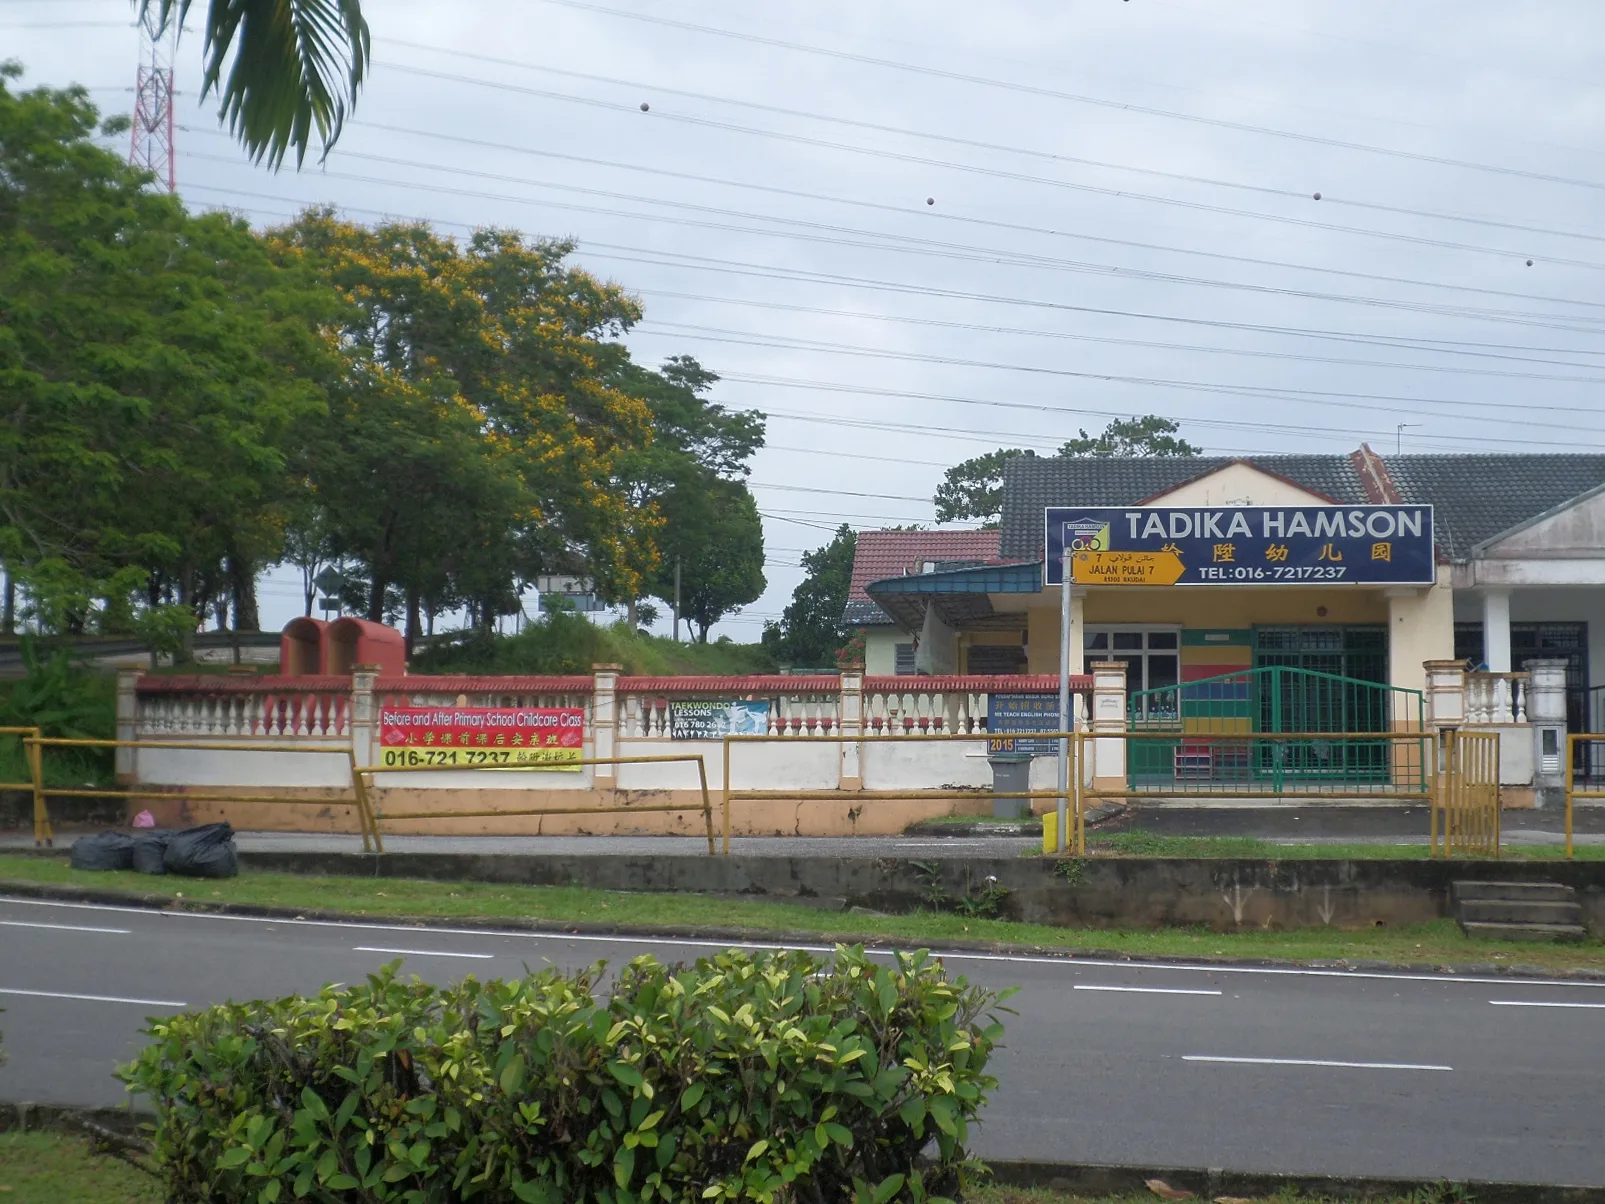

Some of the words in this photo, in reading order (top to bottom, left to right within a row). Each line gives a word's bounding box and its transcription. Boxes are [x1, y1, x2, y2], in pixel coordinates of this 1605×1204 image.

[1125, 512, 1253, 539] TADIKA
[1263, 510, 1422, 538] HAMSON
[1089, 565, 1118, 575] JALAN
[1122, 565, 1145, 575] PULAI
[1149, 566, 1155, 575] 7
[1199, 566, 1347, 579] TEL:016-7217237
[670, 702, 731, 710] TAEKWONDO
[674, 709, 712, 717] LESSONS
[383, 711, 410, 726] Before
[413, 711, 430, 726] and
[431, 712, 452, 726] After
[454, 712, 485, 729] Primary
[486, 712, 515, 727] School
[517, 712, 558, 727] Childcare
[560, 712, 581, 727] Class
[385, 751, 457, 766] 016-721
[466, 751, 510, 765] 7237
